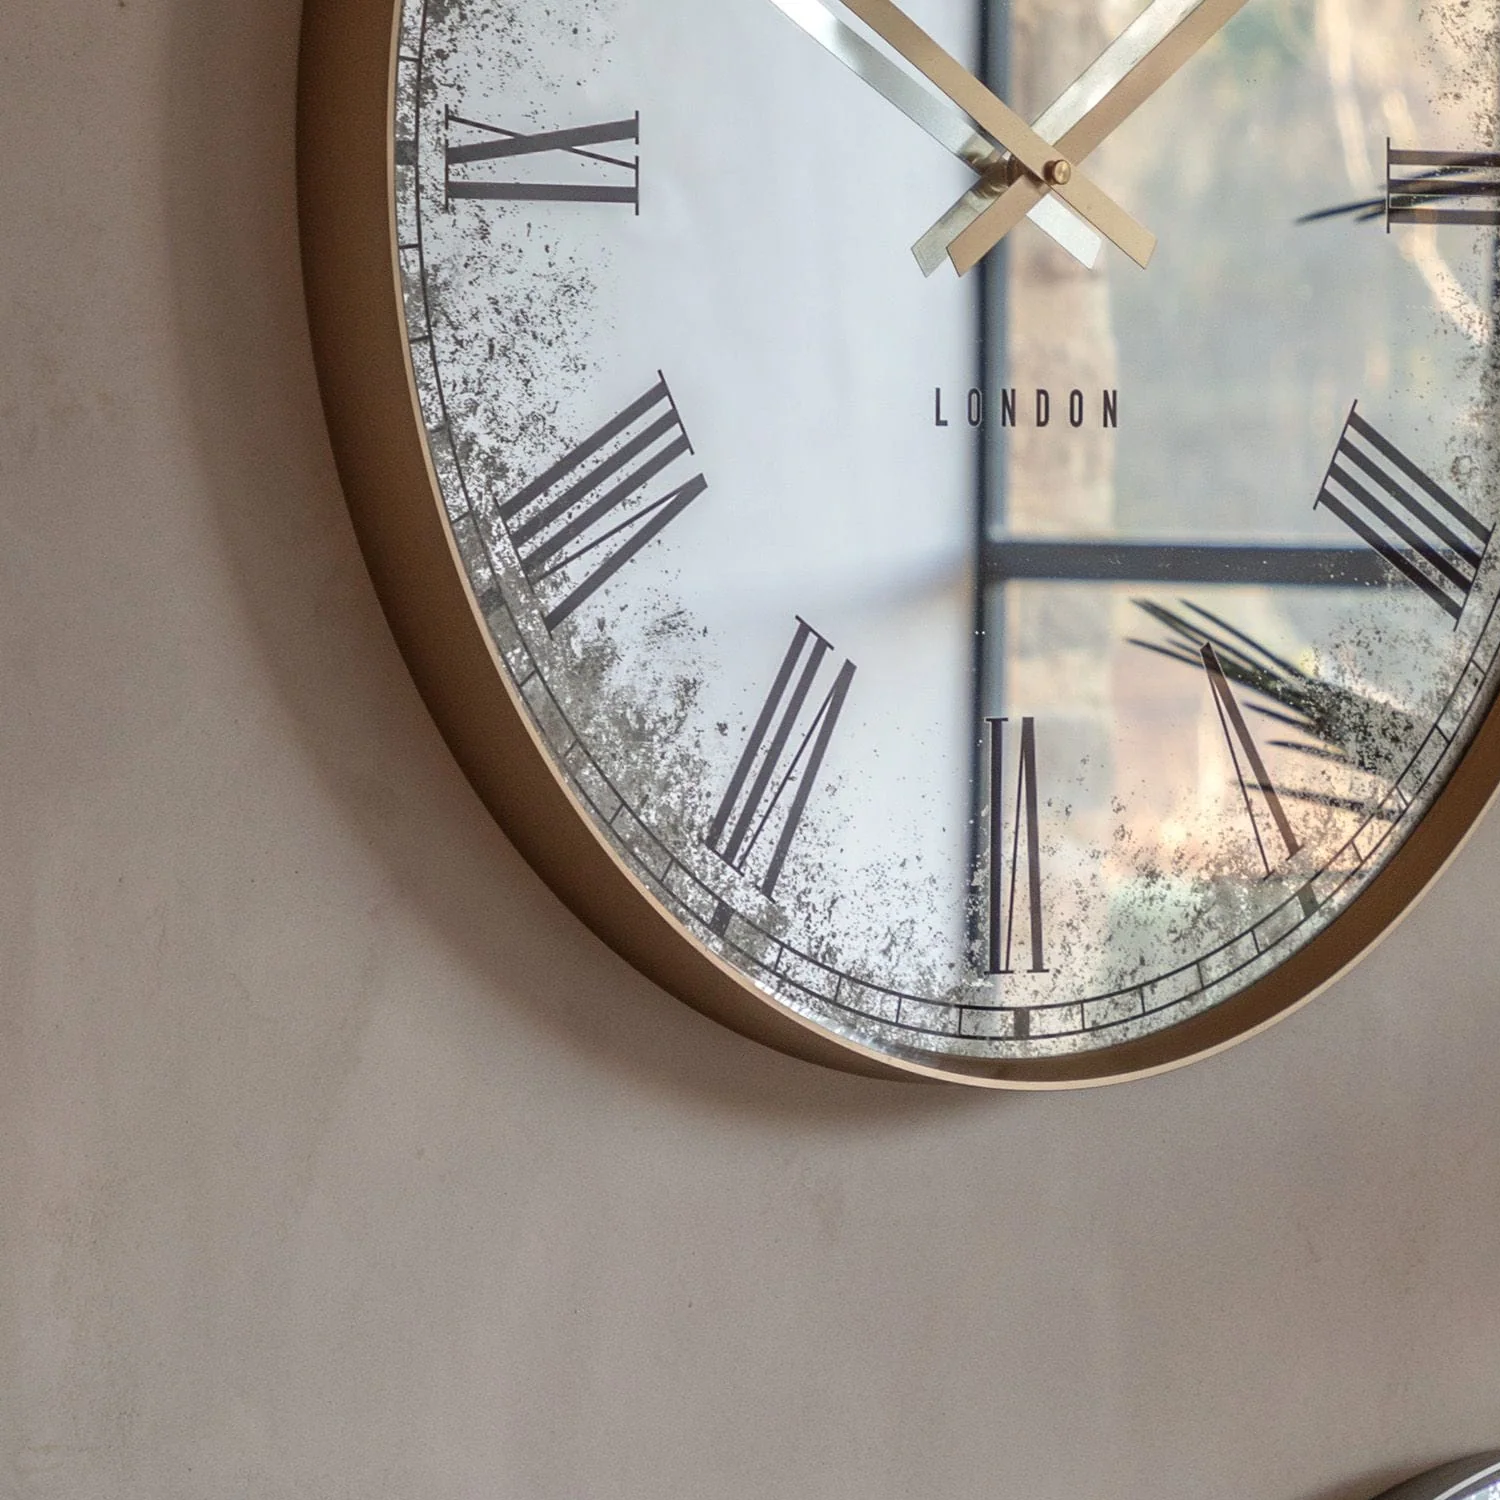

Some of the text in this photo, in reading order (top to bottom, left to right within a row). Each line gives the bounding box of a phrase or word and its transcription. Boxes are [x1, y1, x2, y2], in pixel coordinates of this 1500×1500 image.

[444, 104, 639, 215] IX
[934, 387, 1120, 429] LONDON
[497, 370, 708, 632] VIII
